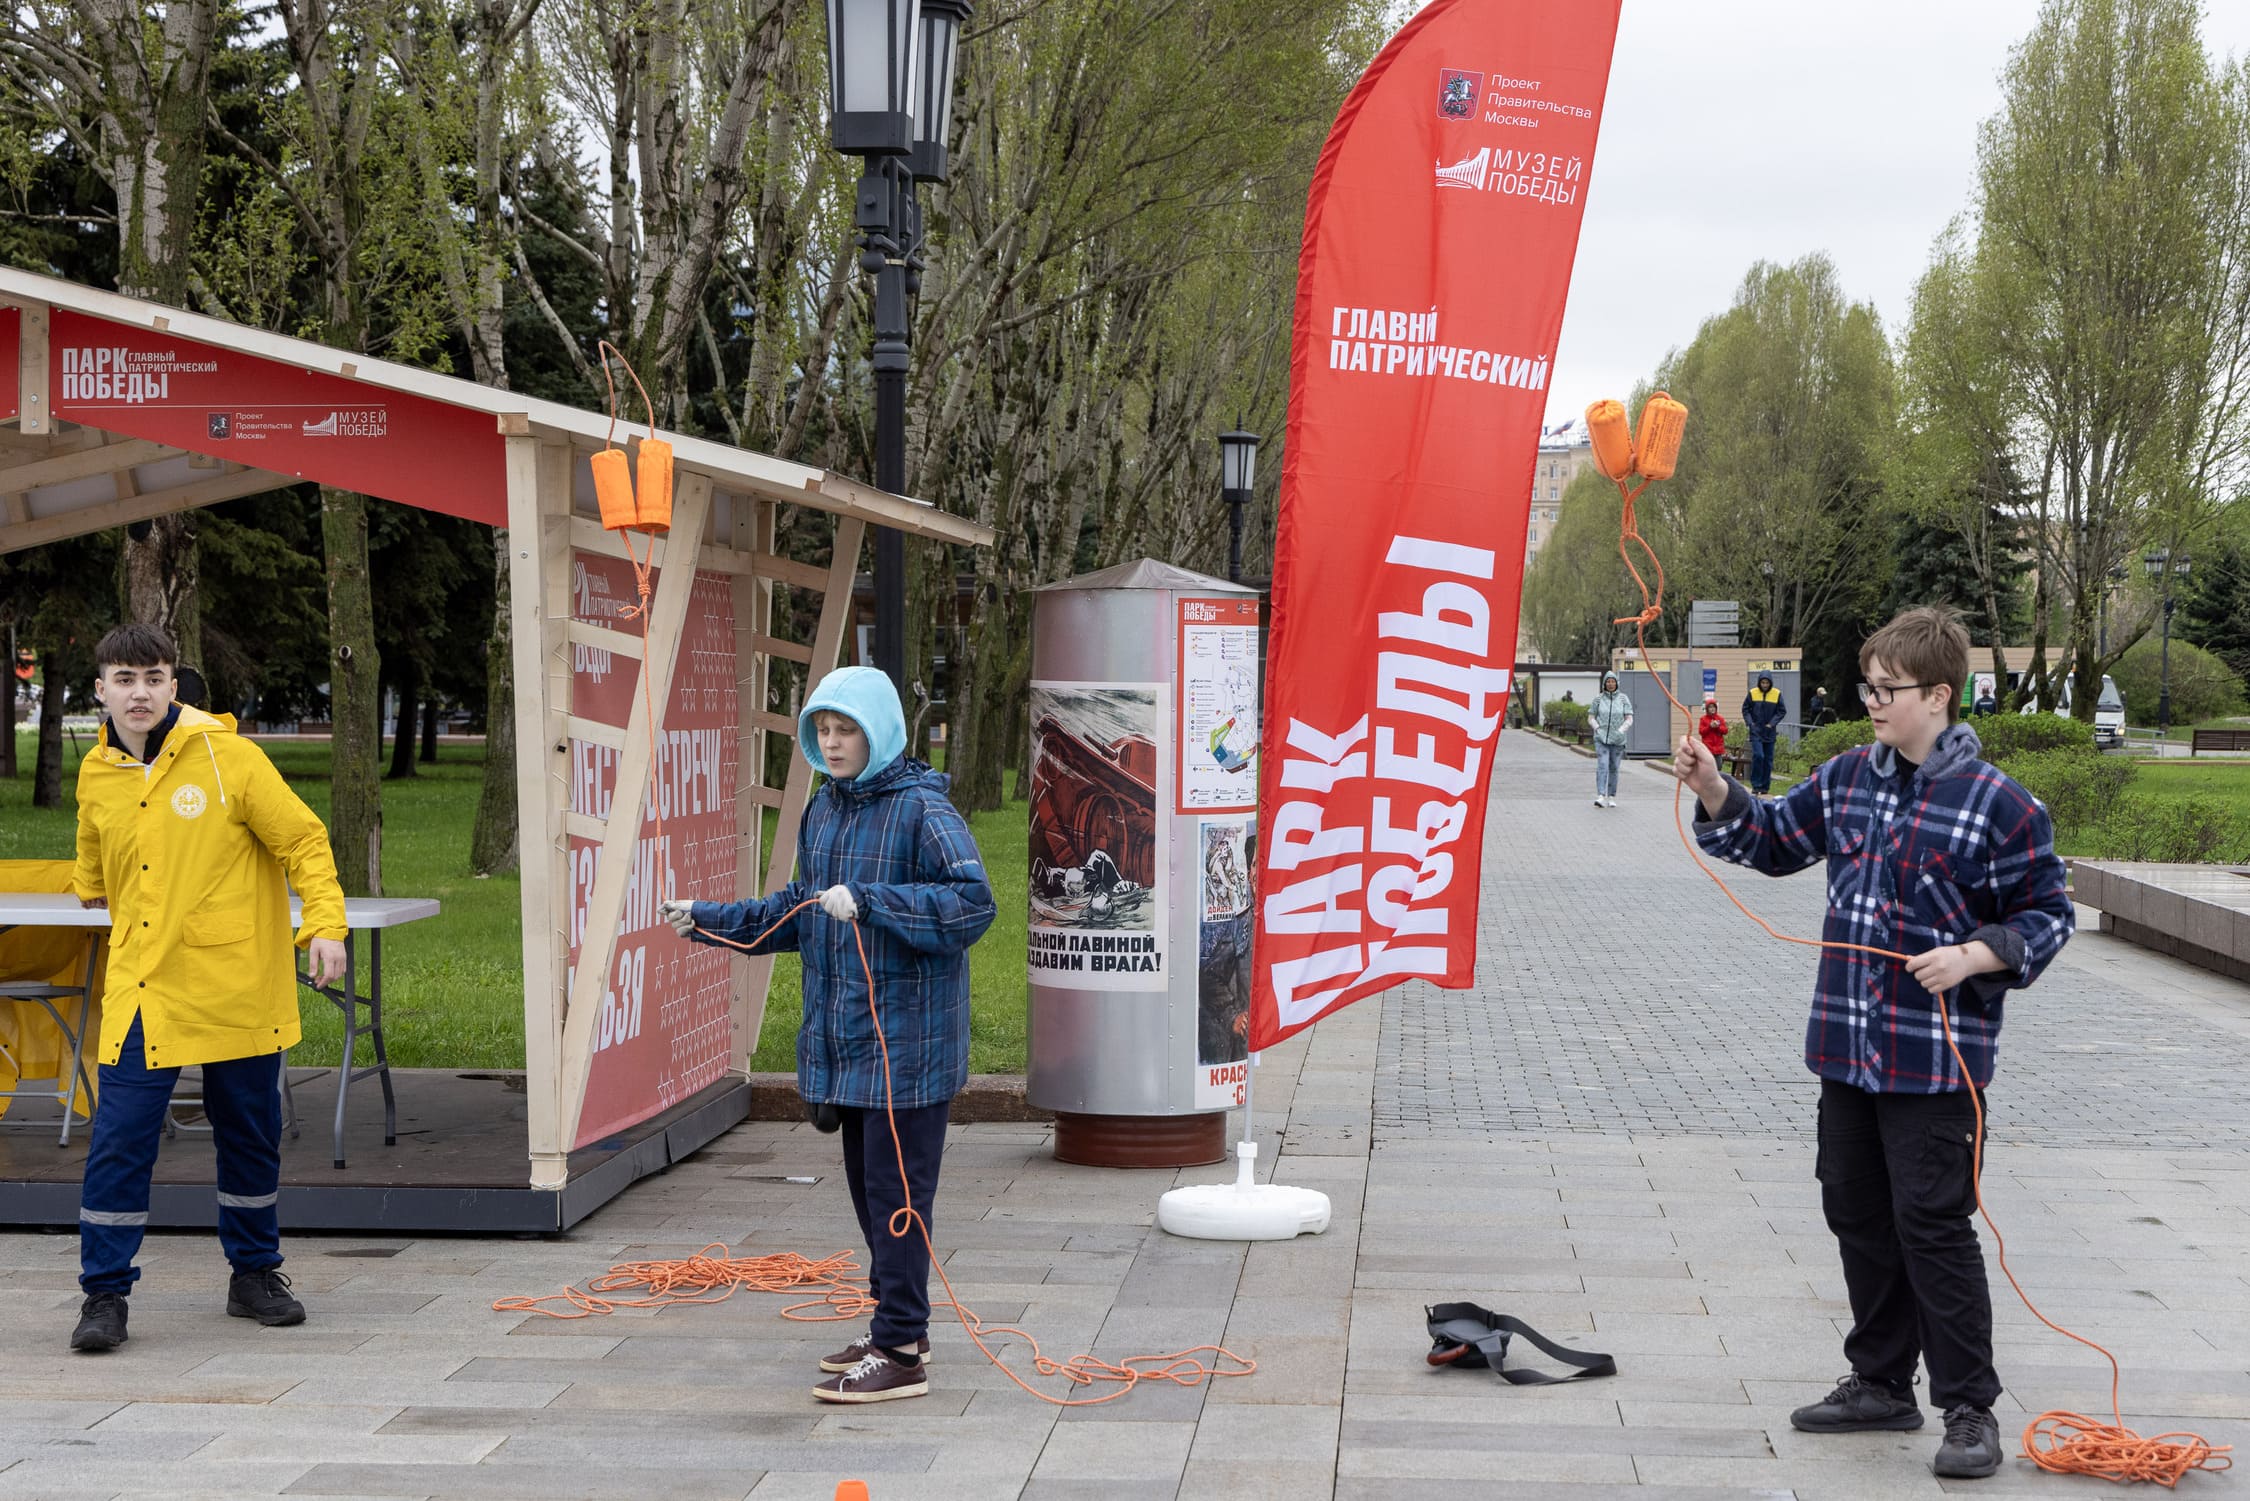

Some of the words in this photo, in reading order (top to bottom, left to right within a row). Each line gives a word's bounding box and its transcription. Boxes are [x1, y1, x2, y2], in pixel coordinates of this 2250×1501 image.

[1491, 74, 1541, 91] Проект
[1488, 93, 1592, 119] Правительства
[1484, 111, 1539, 128] Москвы
[1493, 148, 1582, 181] МУЗЕЙ
[1488, 172, 1577, 205] ПОБЕДЫ
[62, 348, 128, 373] ПАРК
[128, 351, 176, 362] ГЛАВНЫЙ
[128, 361, 218, 373] ПАТРИОТИЧЕСКИЙ
[62, 373, 168, 404] ПОБЕДЫ
[339, 410, 387, 423] МУЗЕЙ
[235, 422, 293, 430] Правительства
[339, 424, 387, 437] ПОБЕДЫ
[235, 432, 266, 440] Москвы
[1184, 603, 1205, 611] ПАРК
[1184, 611, 1216, 622] ПОБЕДЫ
[1345, 535, 1510, 989] ПОБЕДЫ
[1264, 712, 1369, 1030] ПАРК
[1069, 935, 1155, 952] ЛАВИНОЙ
[1091, 953, 1161, 972] ВРАГА!
